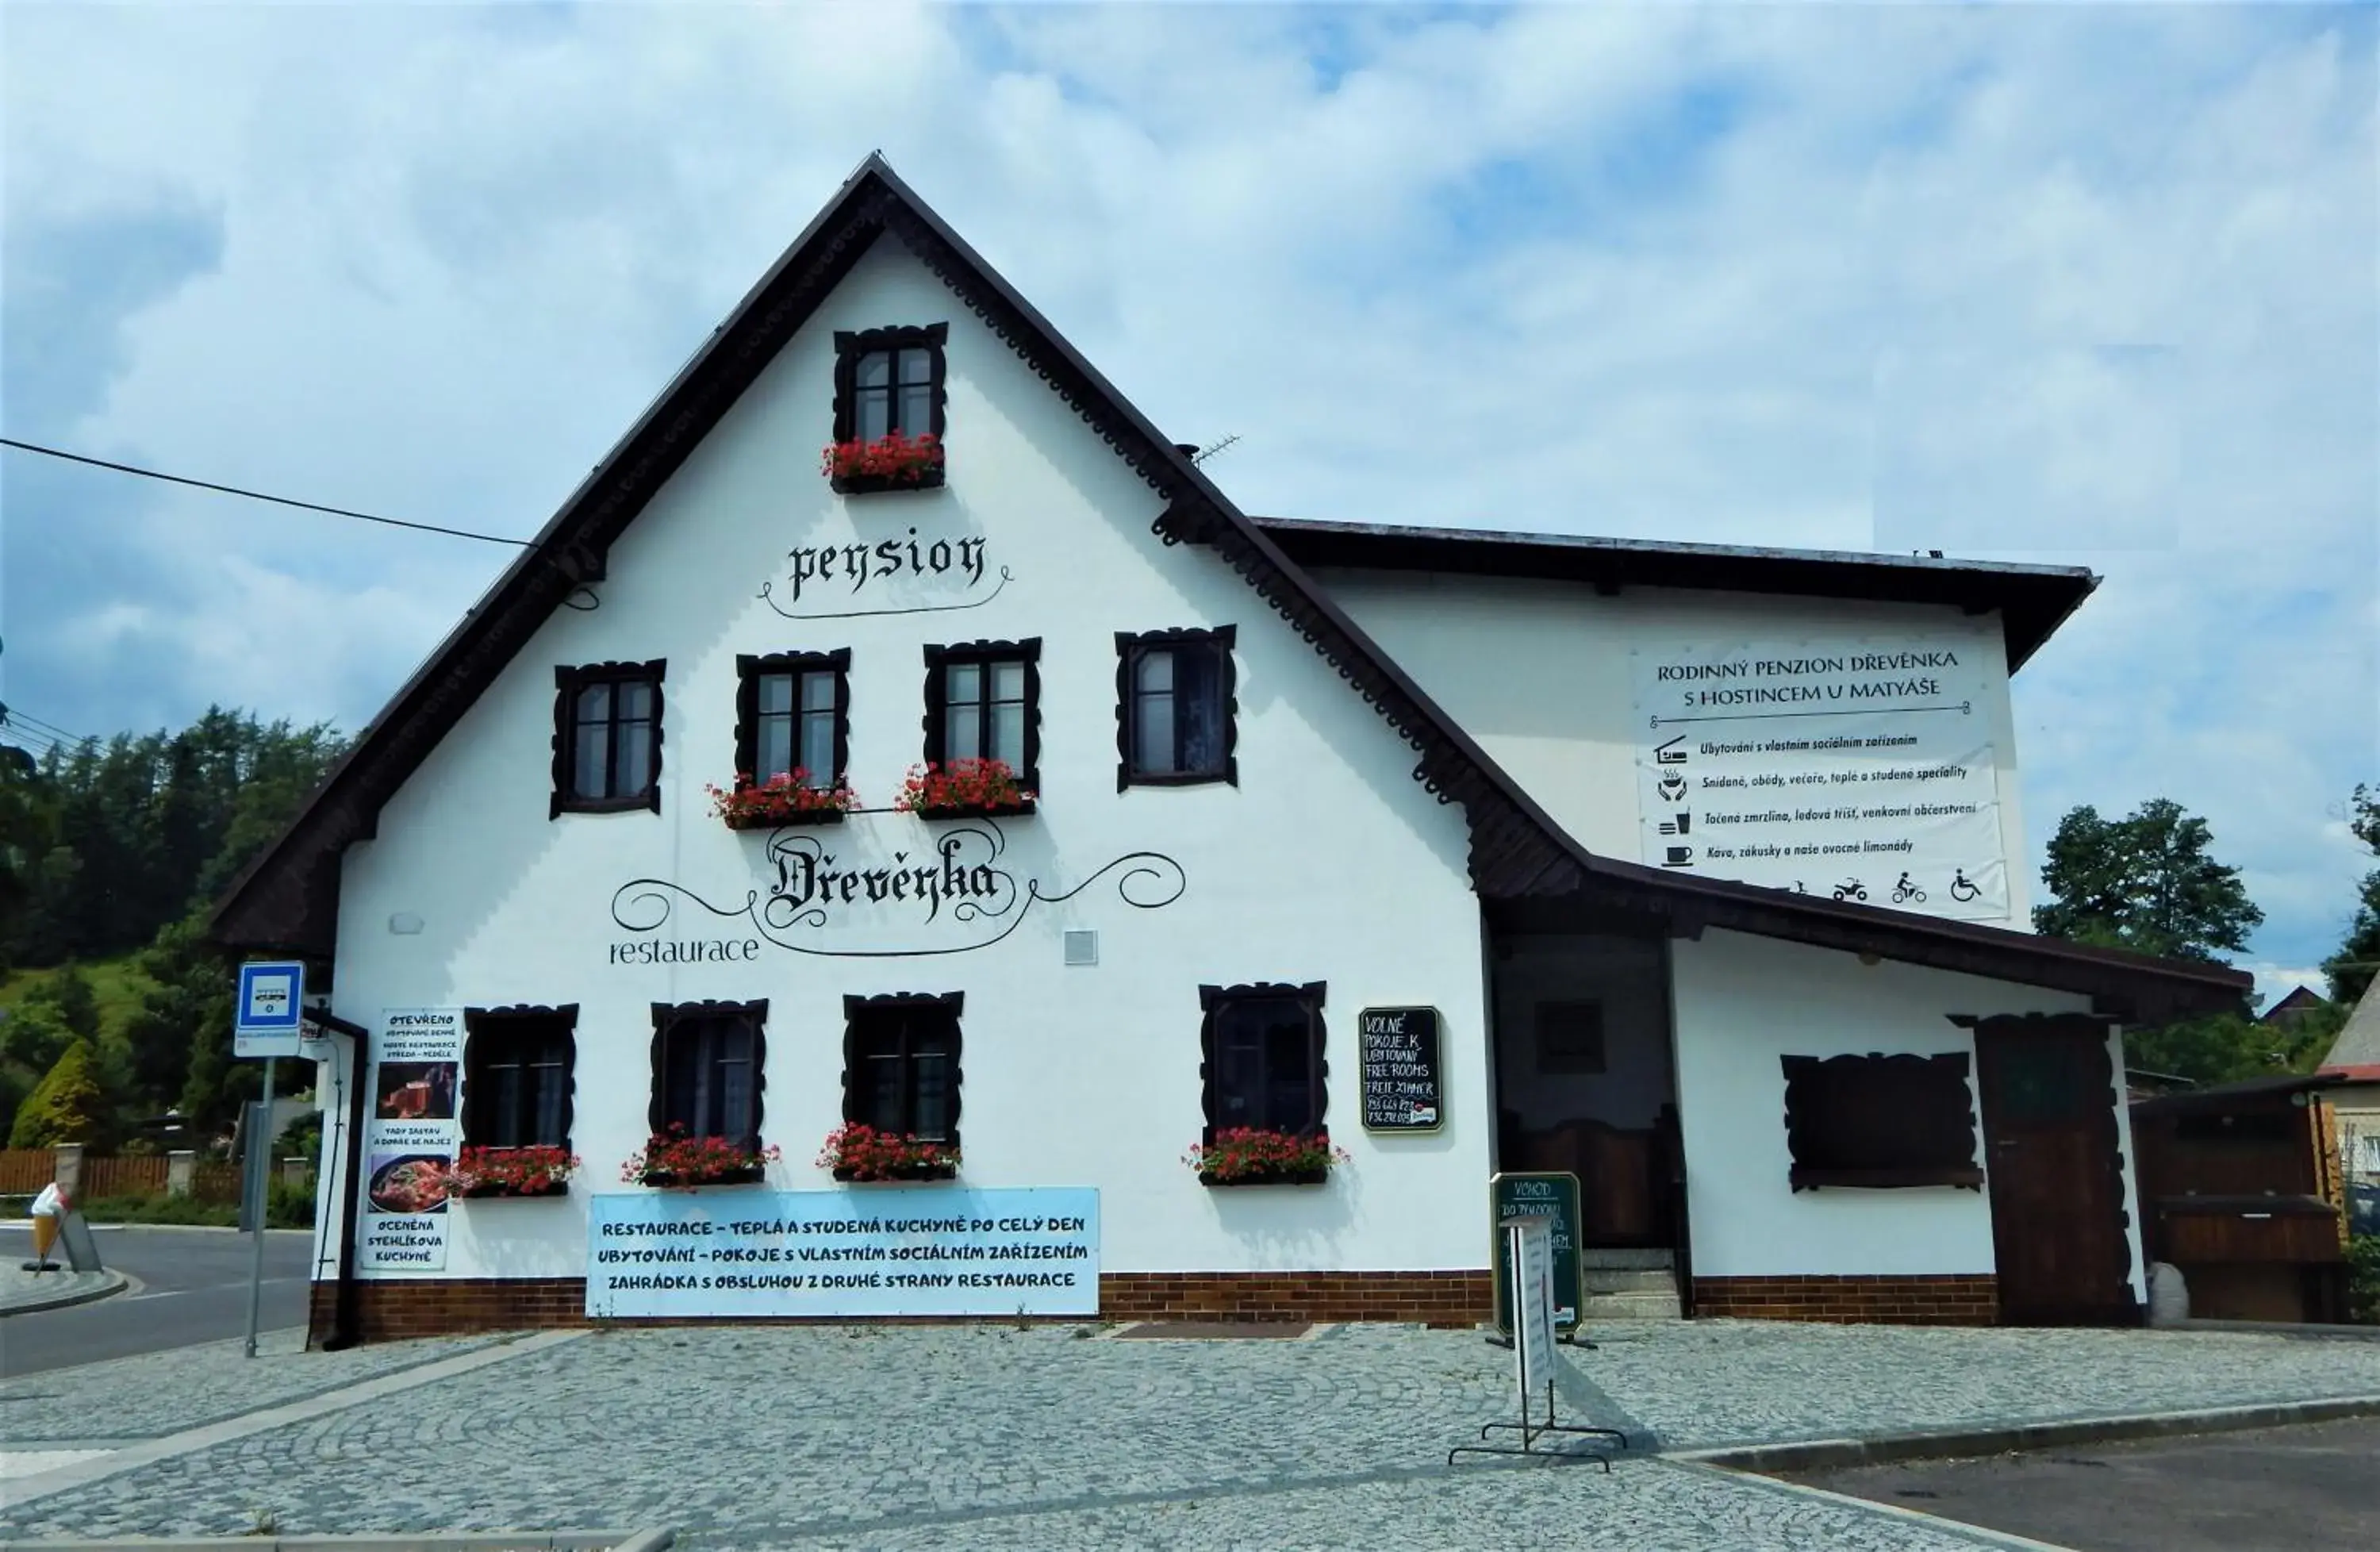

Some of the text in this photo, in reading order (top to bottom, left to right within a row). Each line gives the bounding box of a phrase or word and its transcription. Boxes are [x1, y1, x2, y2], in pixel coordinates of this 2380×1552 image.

[788, 527, 986, 603] pension
[1658, 651, 1959, 681] RODINNÝ PENZION DŘEVĚNKA
[1683, 677, 1941, 706] S HOSTINCEM U MATYÁŠE
[1700, 733, 1917, 756] Ubytování s vlastním sociálním zařízením
[1830, 769, 1858, 785] teplé
[1860, 772, 1868, 782] a
[1871, 767, 1914, 782] studené
[1916, 763, 1967, 782] speciality
[1705, 812, 1741, 825] Točená
[1795, 807, 1831, 821] ledová
[1862, 804, 1912, 819] venkovní
[1914, 801, 1977, 816] občerstvení
[1739, 843, 1782, 859] zákusky
[1784, 847, 1791, 857] a
[1794, 841, 1819, 855] naše
[1822, 841, 1860, 855] ovocné
[1863, 838, 1914, 854] limonády
[766, 838, 1000, 925] Dřevěnka
[609, 937, 760, 965] restaurace
[390, 1013, 455, 1025] OTEVŘENO
[1365, 1012, 1407, 1034] VOLNÉ
[1410, 1034, 1419, 1048] K
[1365, 1064, 1429, 1078] FREE ROOMS
[1365, 1081, 1395, 1095] FREIE
[1514, 1181, 1551, 1196] VCHOD
[378, 1219, 434, 1231] OCENĚNÁ
[602, 1220, 712, 1236] RESTAURACE
[730, 1218, 782, 1235] TEPLÁ
[788, 1221, 798, 1235] A
[802, 1216, 881, 1235] STUDENÁ
[885, 1214, 967, 1234] KUCHYNĚ
[971, 1220, 994, 1233] PO
[998, 1215, 1046, 1231] CELÝ
[1047, 1217, 1085, 1231] DEN
[367, 1235, 443, 1247] STEHLÍKOVA
[598, 1246, 697, 1263] UBYTOVÁNÍ
[712, 1247, 781, 1262] POKOJE
[784, 1248, 794, 1262] S
[798, 1243, 886, 1262] VLASTNÍM
[889, 1243, 985, 1261] SOCIÁLNÍM
[988, 1242, 1088, 1260] ZAŘÍZENÍM
[608, 1270, 1076, 1290] ZAHRÁDKA S OBSLUHOU Z DRUHÉ STRANY RESTAURACE
